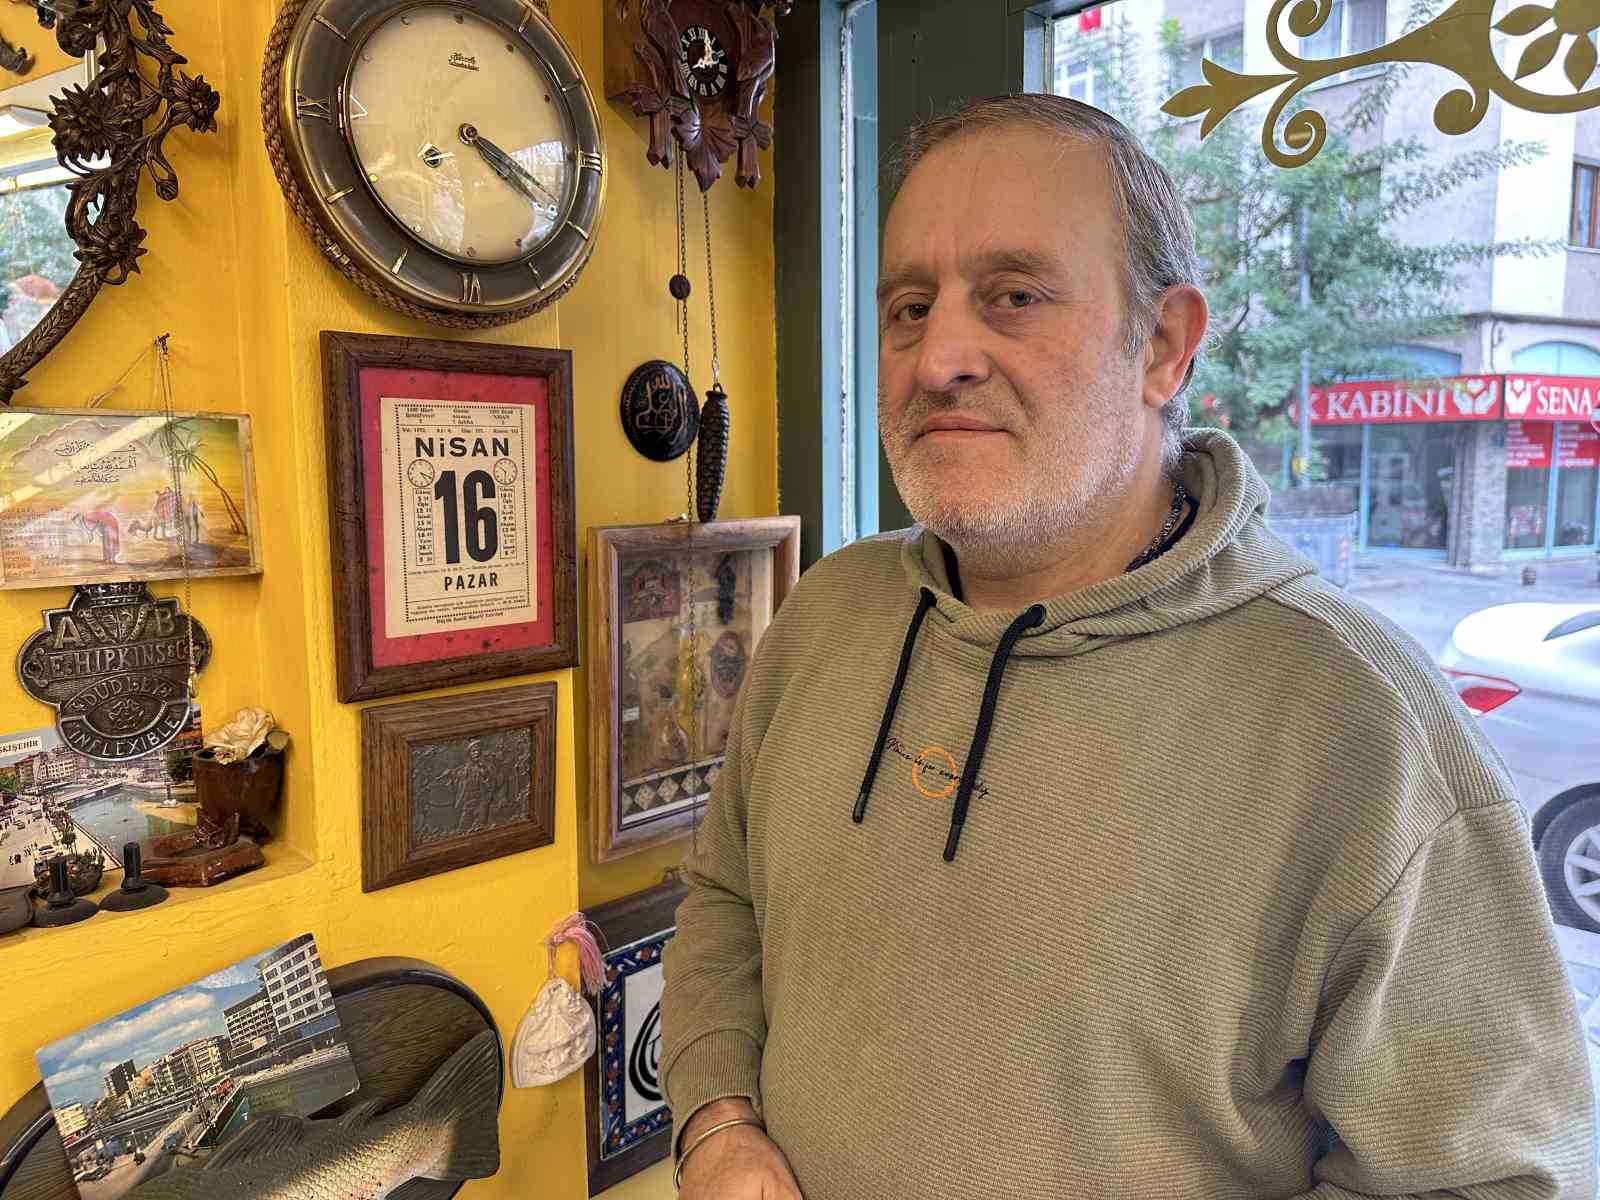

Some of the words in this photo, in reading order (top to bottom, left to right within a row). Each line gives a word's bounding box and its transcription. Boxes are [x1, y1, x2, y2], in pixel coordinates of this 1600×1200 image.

[1535, 385, 1593, 416] SENA
[434, 469, 498, 565] 16
[444, 572, 499, 591] PAZAR
[53, 616, 85, 649] A
[156, 608, 175, 637] B
[74, 644, 167, 674] HIPKINS
[82, 676, 163, 707] DUDLEY
